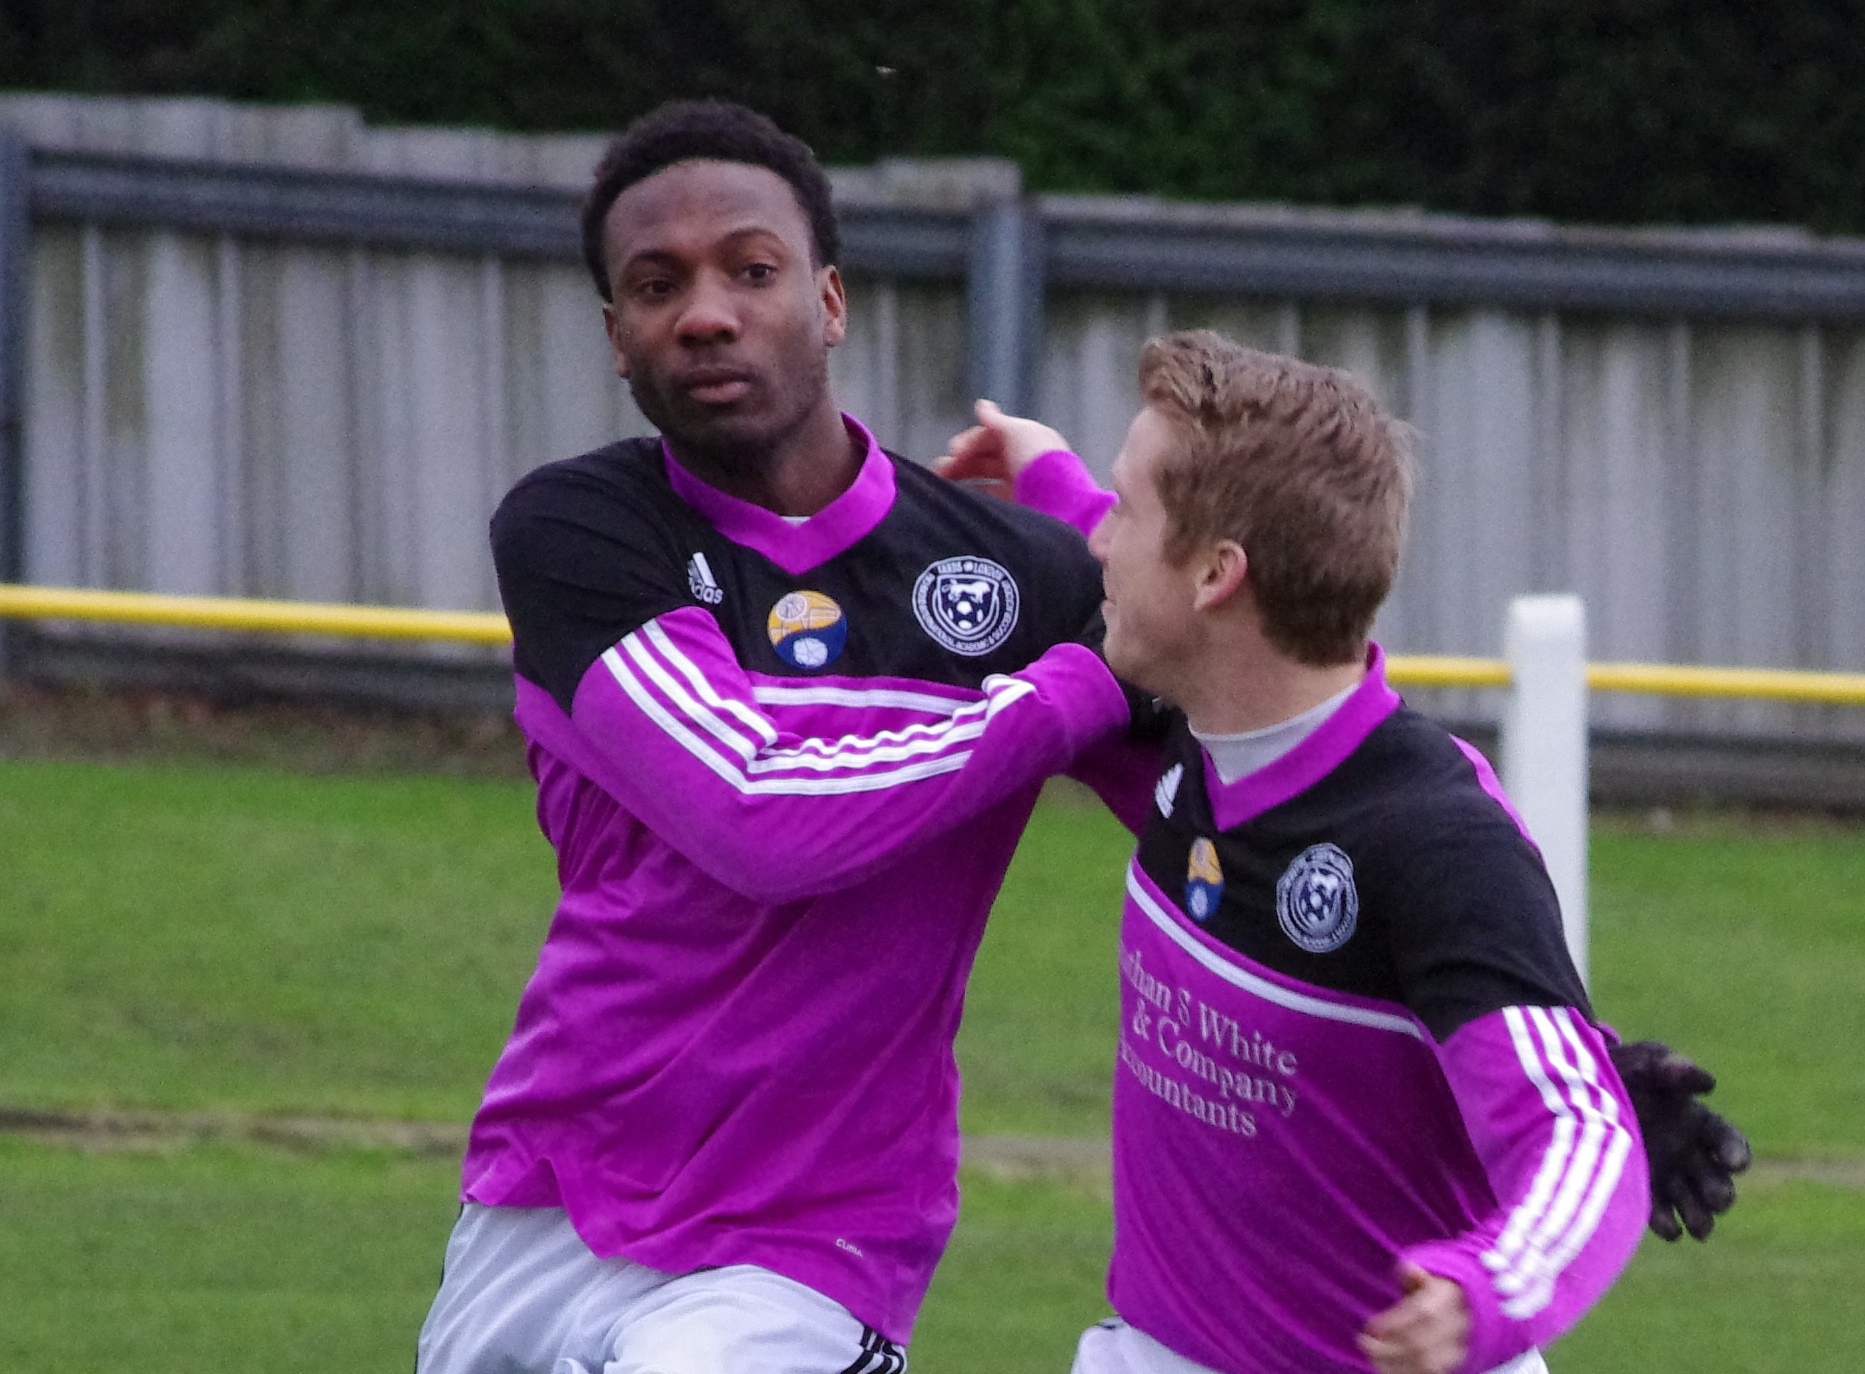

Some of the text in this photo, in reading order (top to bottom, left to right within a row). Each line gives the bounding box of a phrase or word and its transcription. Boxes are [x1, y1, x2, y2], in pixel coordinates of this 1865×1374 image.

[1132, 996, 1297, 1118] & Company
[1177, 987, 1192, 1028] S
[1199, 1000, 1298, 1077] White
